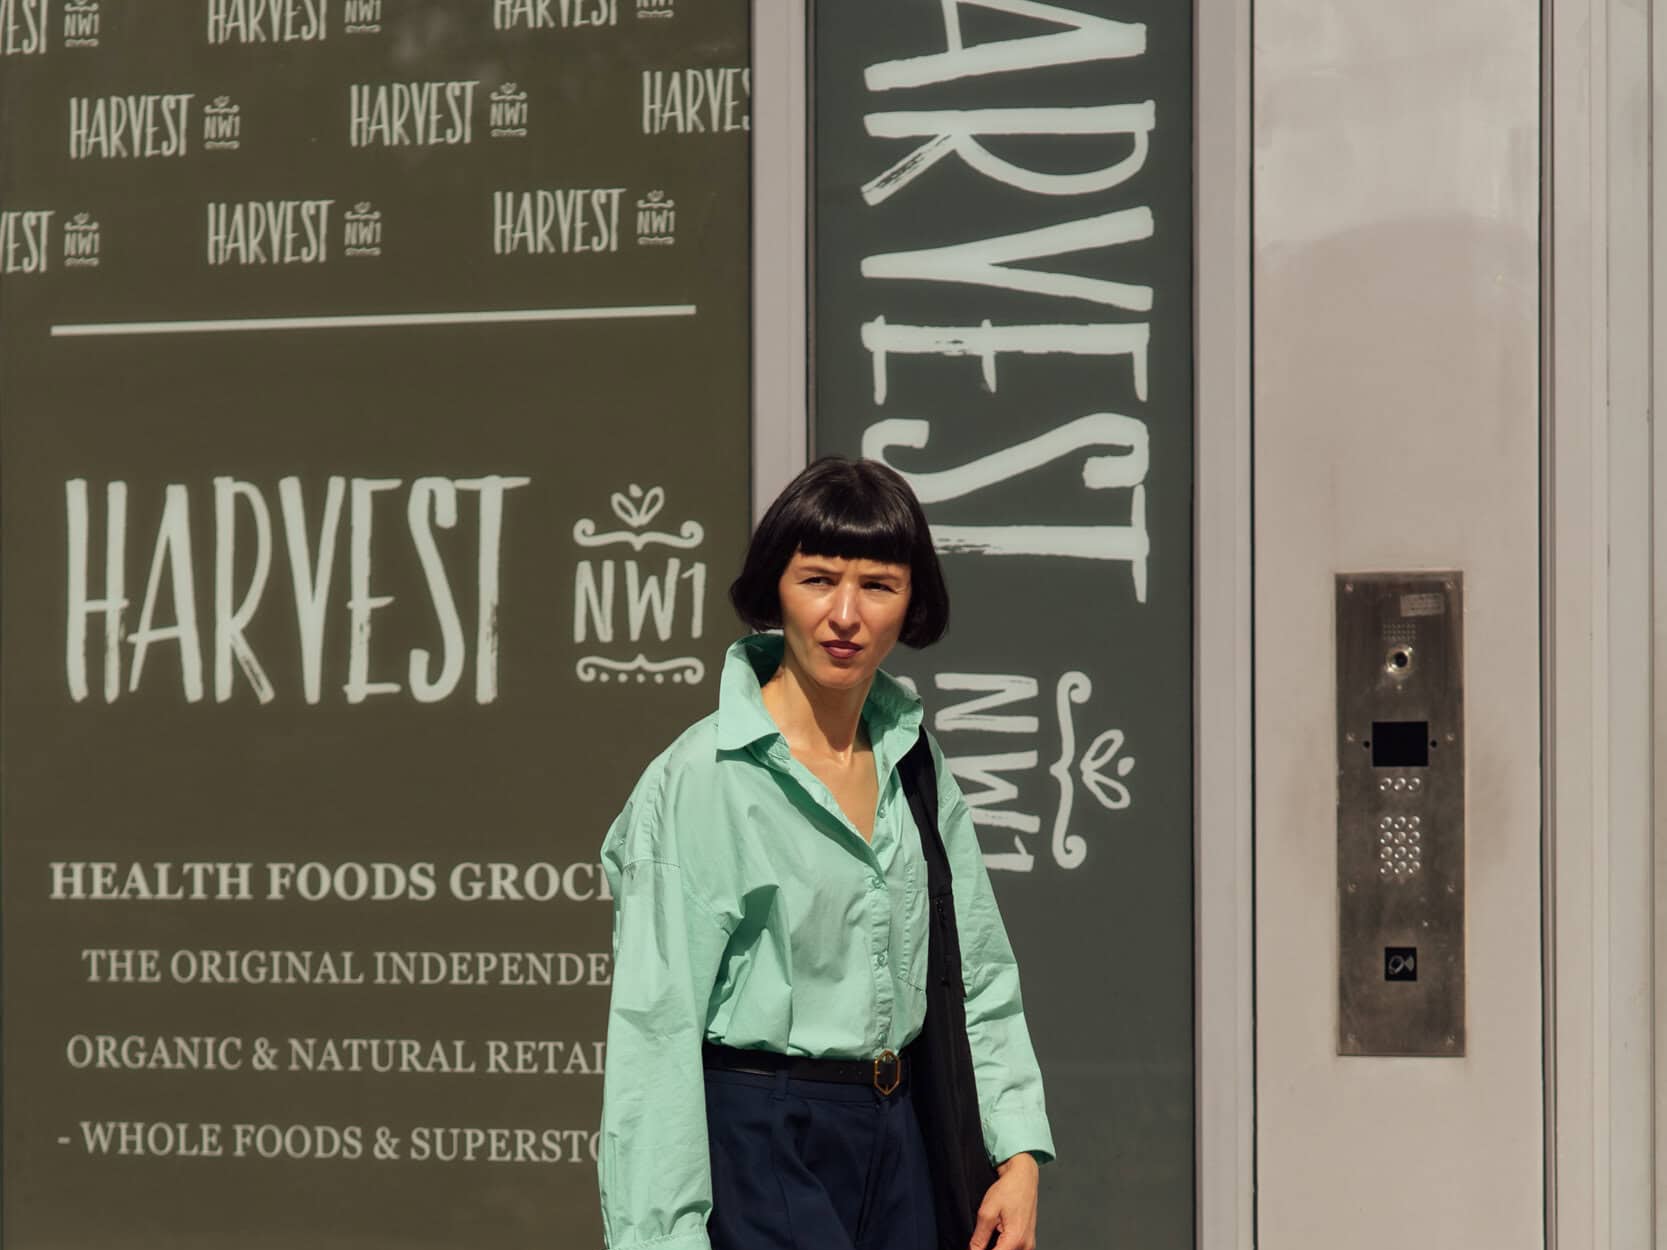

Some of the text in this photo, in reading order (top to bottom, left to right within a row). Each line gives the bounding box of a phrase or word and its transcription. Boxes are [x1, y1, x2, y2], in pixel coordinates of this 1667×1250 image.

[0, 0, 99, 55] EST NW1
[69, 93, 240, 158] HARVEST NW1
[351, 81, 528, 147] HARVEST NW1
[64, 231, 99, 257] NW1
[207, 200, 381, 264] HARVEST NW1
[494, 188, 675, 254] HARVEST NW1
[65, 475, 706, 704] HARVEST NW1
[934, 672, 1040, 872] NW1
[50, 862, 253, 900] HEALTH
[266, 862, 437, 901] FOODS
[81, 949, 612, 986] THE ORIGINAL INDEPENDE
[66, 1035, 243, 1070] ORGANIC
[252, 1038, 278, 1071] &
[288, 1038, 476, 1073] NATURAL
[81, 1121, 223, 1156] WHOLE
[234, 1124, 363, 1159] FOODS
[373, 1126, 400, 1160] &
